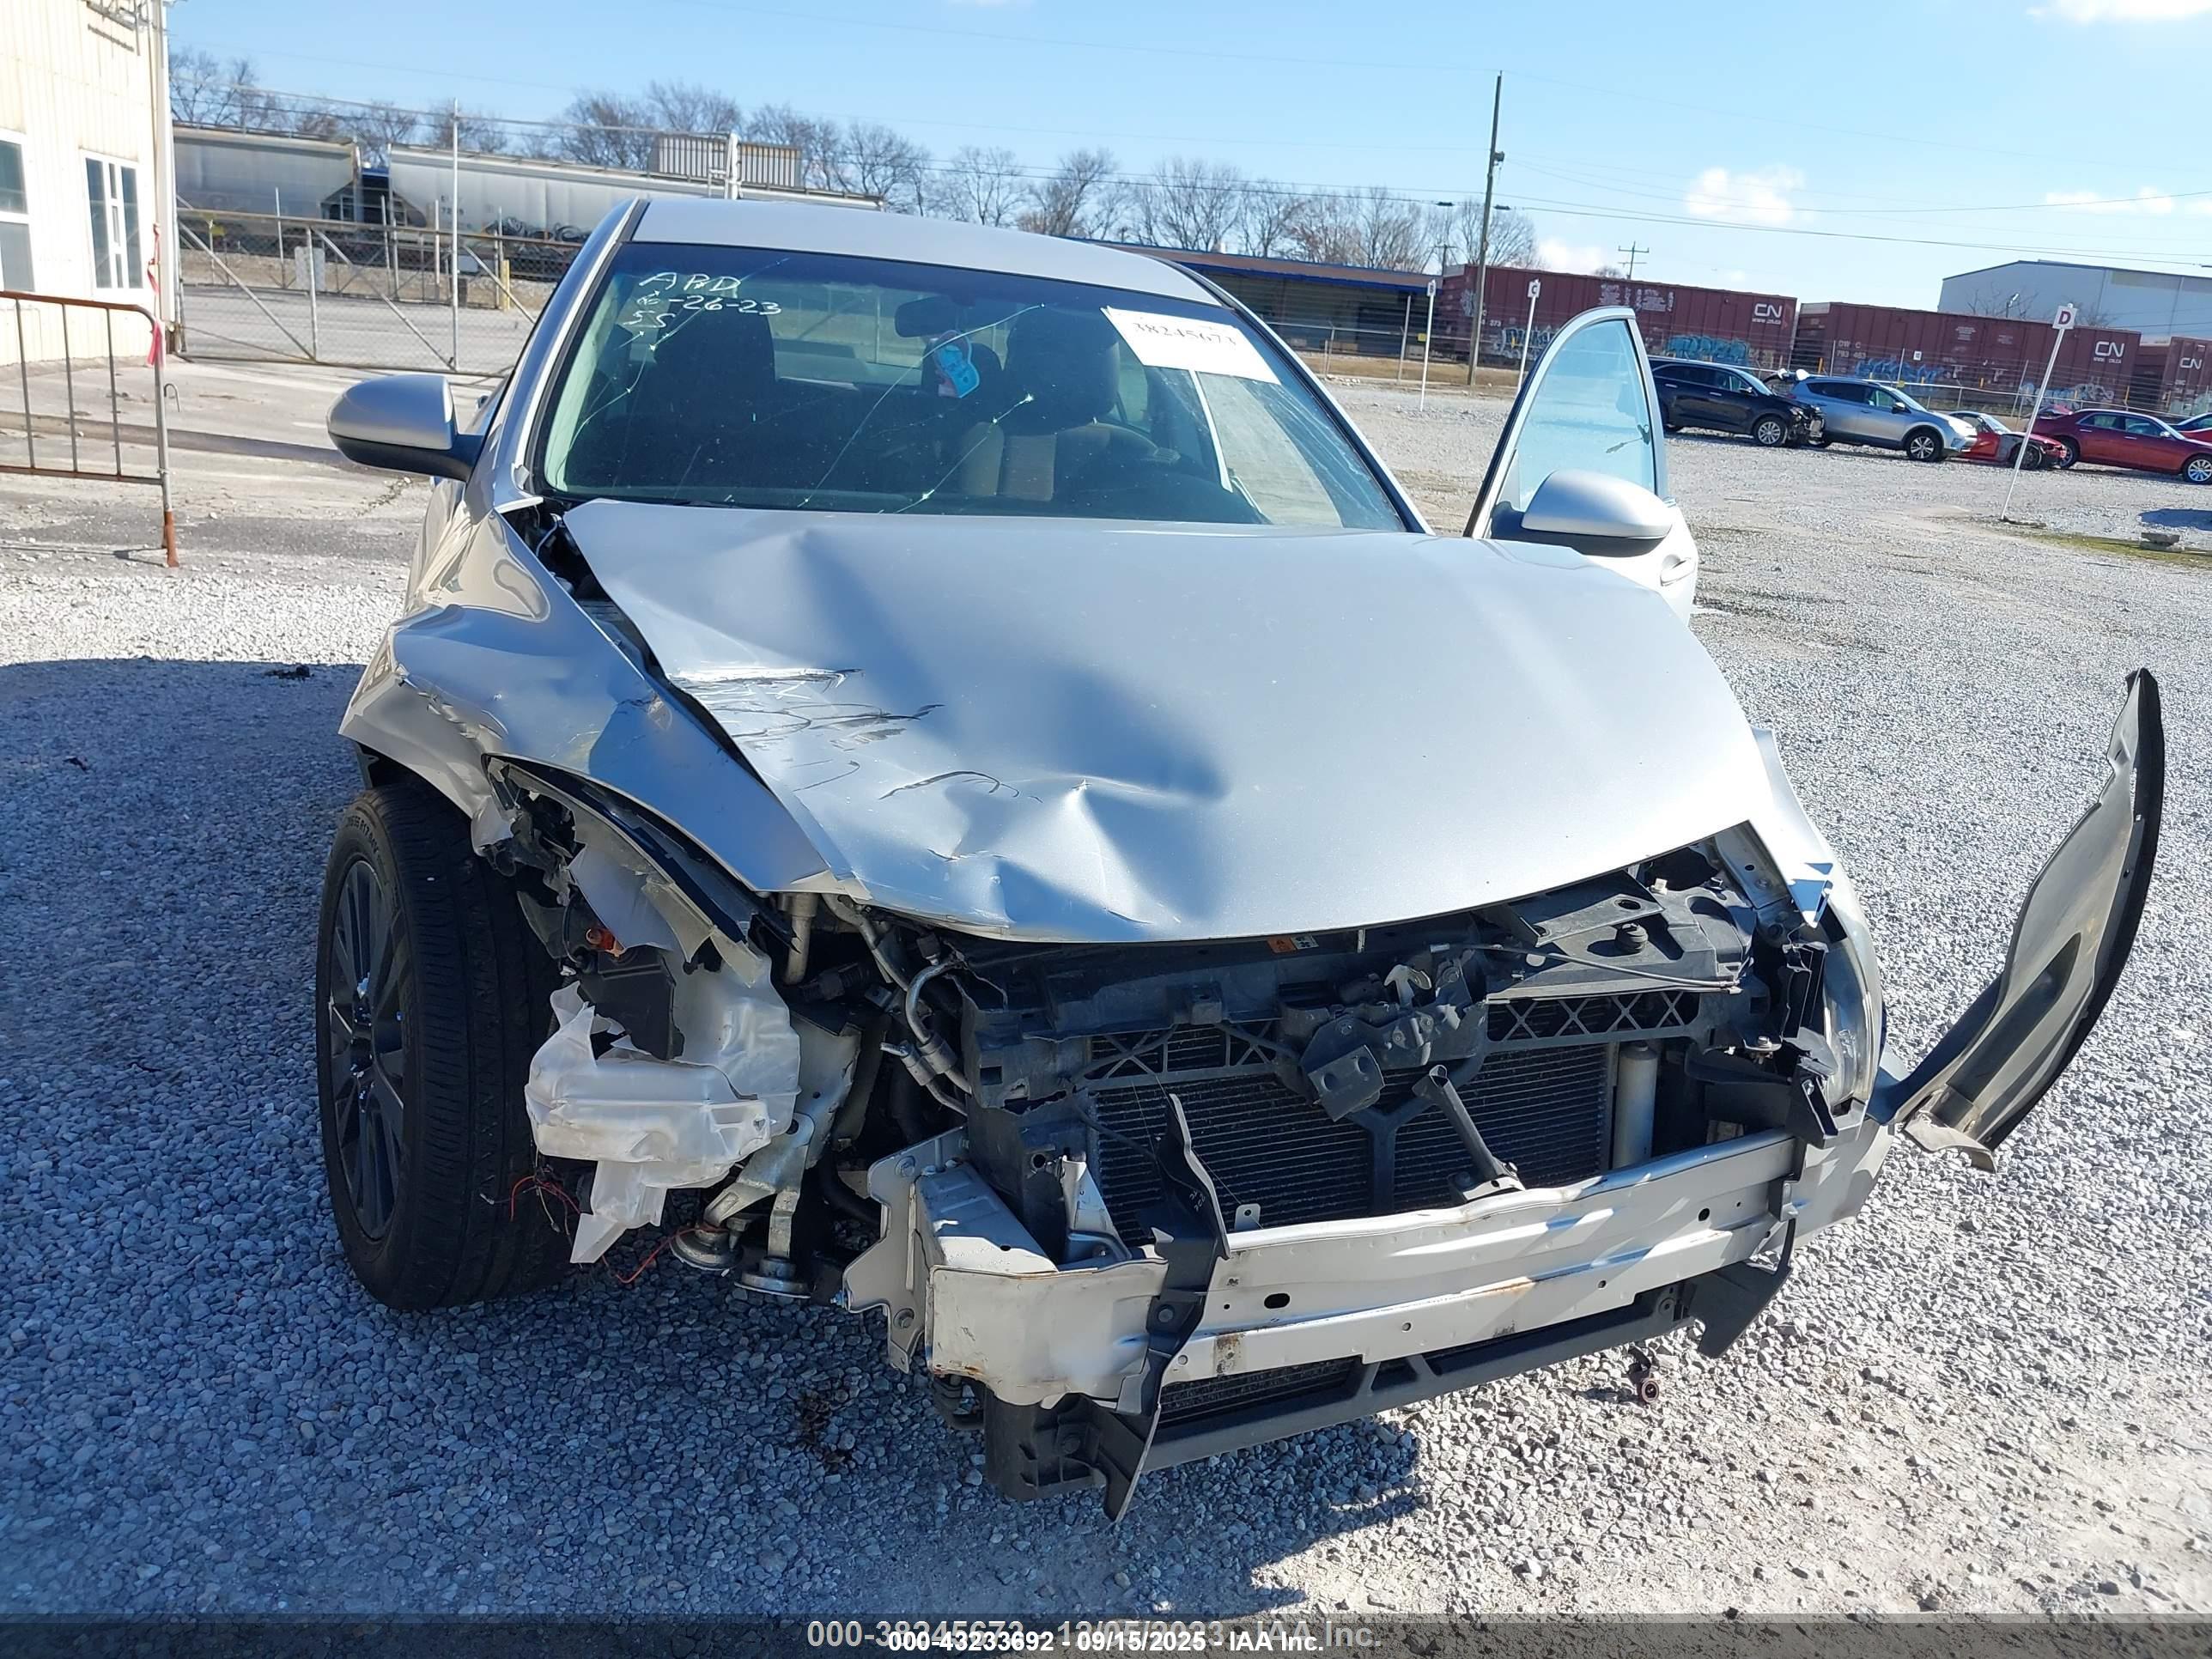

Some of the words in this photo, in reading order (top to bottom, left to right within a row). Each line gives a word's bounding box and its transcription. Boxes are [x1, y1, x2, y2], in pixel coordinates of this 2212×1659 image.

[1531, 284, 1538, 295] C
[1754, 303, 1783, 319] CN
[2057, 310, 2072, 325] D
[2094, 341, 2125, 358] CN
[2179, 357, 2203, 369] CN
